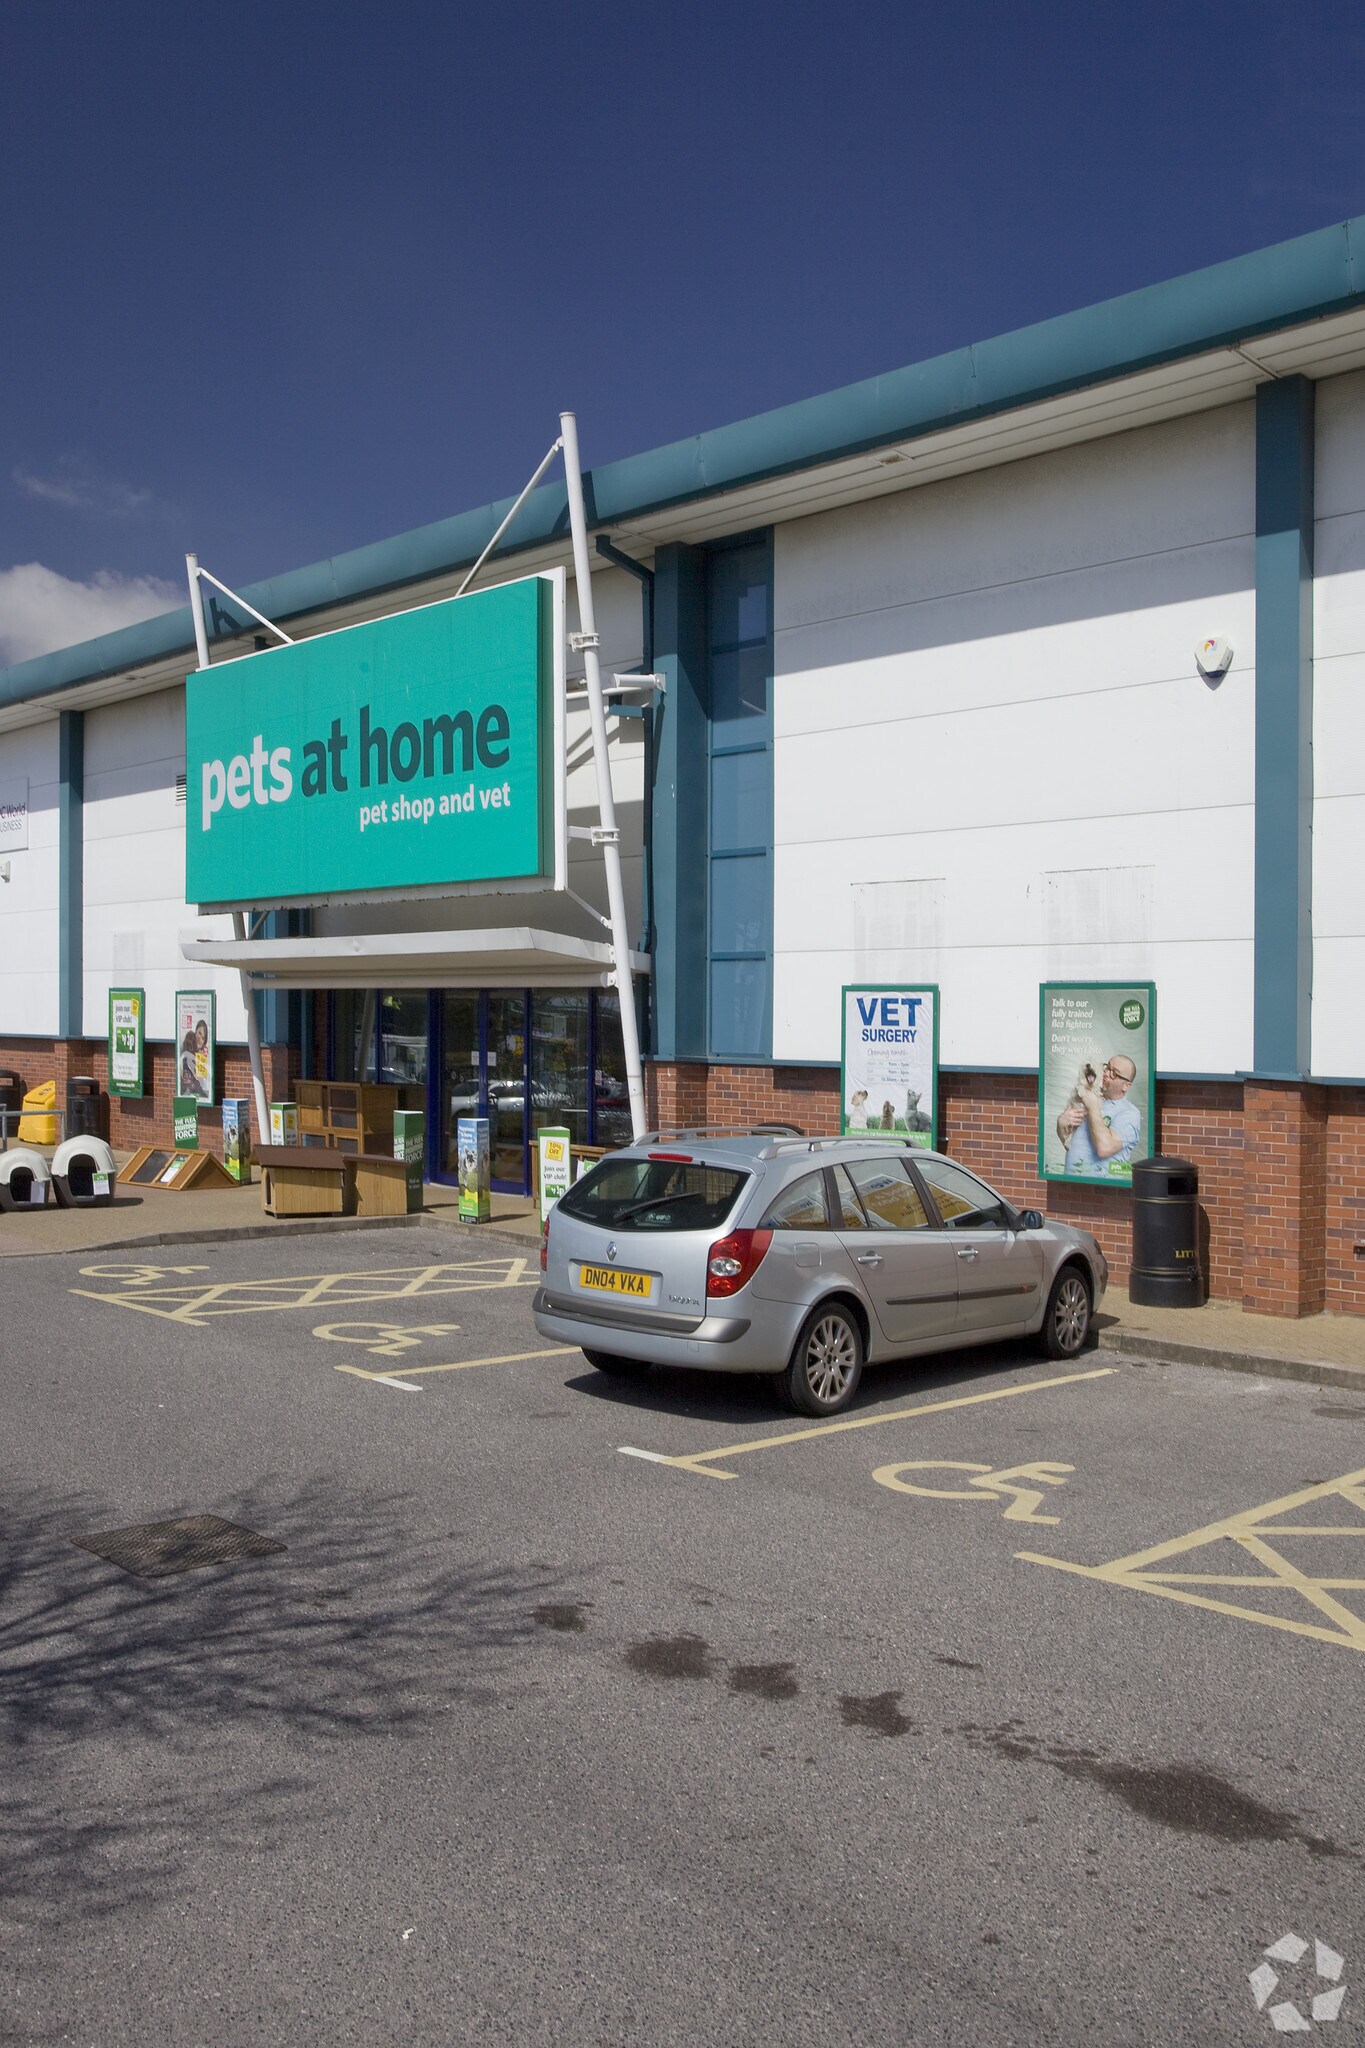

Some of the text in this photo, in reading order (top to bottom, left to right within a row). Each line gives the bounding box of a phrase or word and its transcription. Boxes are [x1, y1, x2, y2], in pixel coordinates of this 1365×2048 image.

[202, 704, 511, 832] pets at home
[360, 781, 511, 832] pet shop and vet
[1052, 998, 1089, 1008] Talk to our
[856, 997, 922, 1027] VET
[1051, 1008, 1094, 1020] fully trained
[1066, 1019, 1093, 1031] fighters
[862, 1029, 917, 1044] SURGERY
[1051, 1033, 1070, 1043] Don't
[1051, 1044, 1067, 1055] they
[175, 1129, 197, 1140] FORCE
[585, 1268, 644, 1294] DN04 VKA
